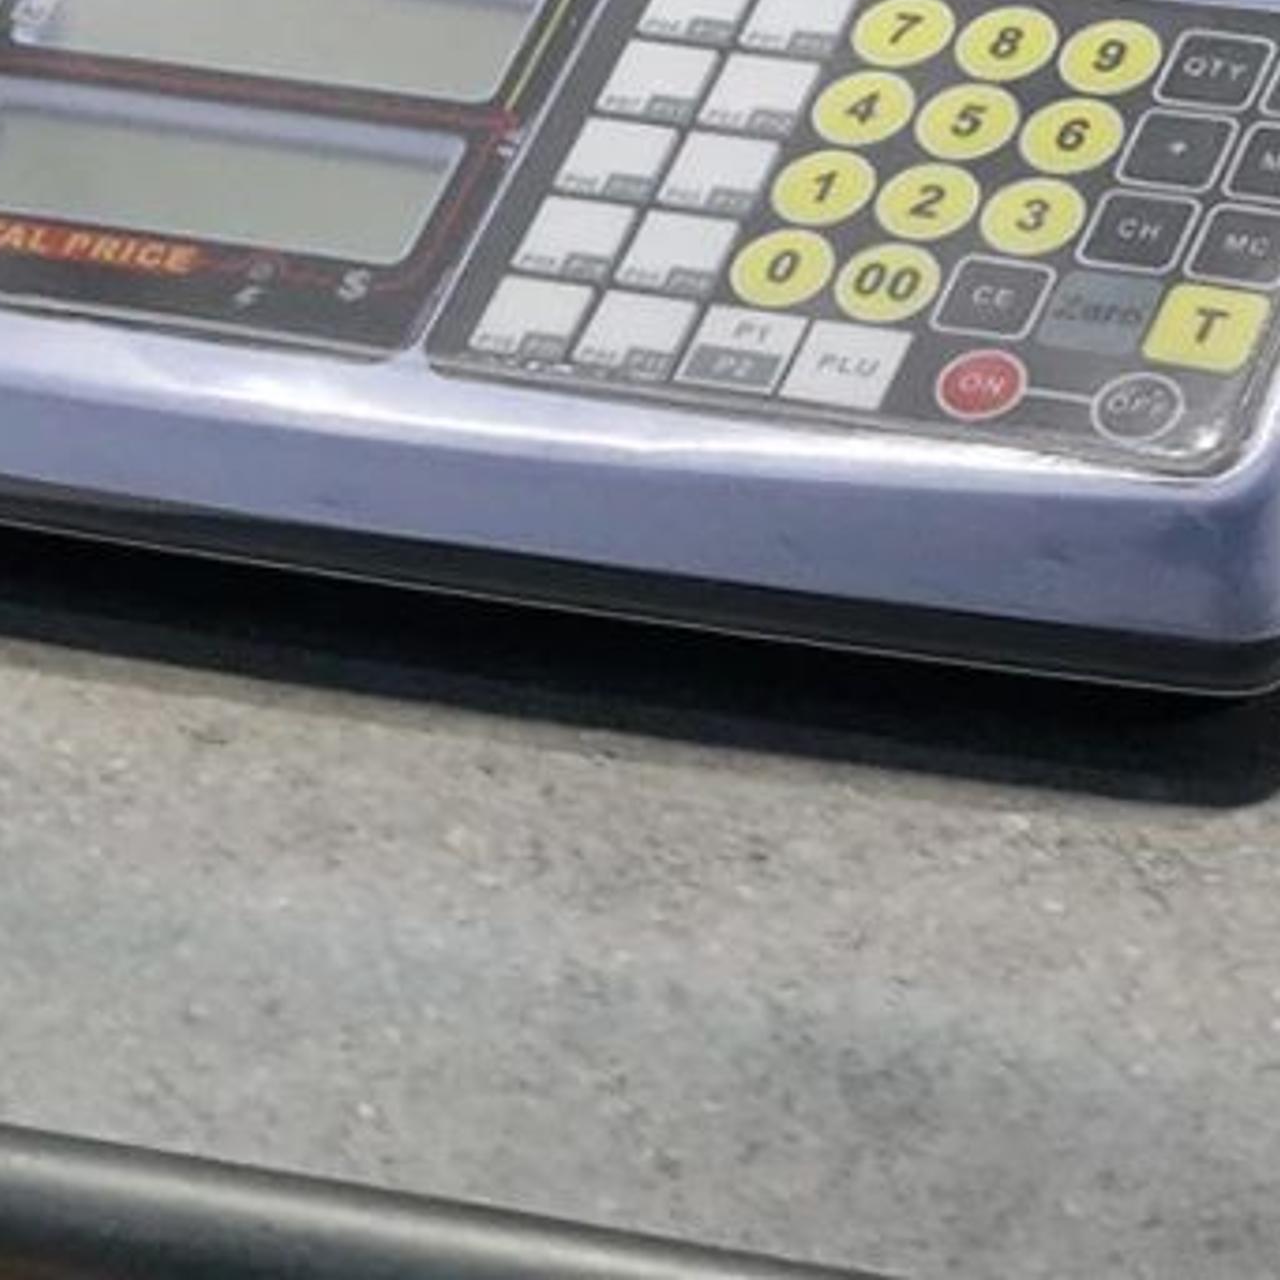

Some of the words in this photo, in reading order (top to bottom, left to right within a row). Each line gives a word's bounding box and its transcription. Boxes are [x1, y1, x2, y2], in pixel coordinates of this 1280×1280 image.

[889, 12, 925, 45] 7
[988, 26, 1024, 60] 8
[1091, 38, 1128, 73] 9
[1182, 56, 1247, 81] QTY
[846, 90, 882, 125] 4
[949, 103, 988, 138] 5
[1055, 118, 1092, 152] 6
[813, 170, 838, 204] 1
[909, 184, 946, 220] 2
[1015, 199, 1051, 233] 3
[1117, 218, 1162, 240] CH
[62, 232, 202, 276] PRICE
[766, 249, 802, 285] 0
[852, 262, 923, 303] 00
[971, 283, 1016, 308] CE
[1189, 307, 1232, 345] T
[817, 352, 881, 377] PLU
[957, 372, 1004, 397] ON
